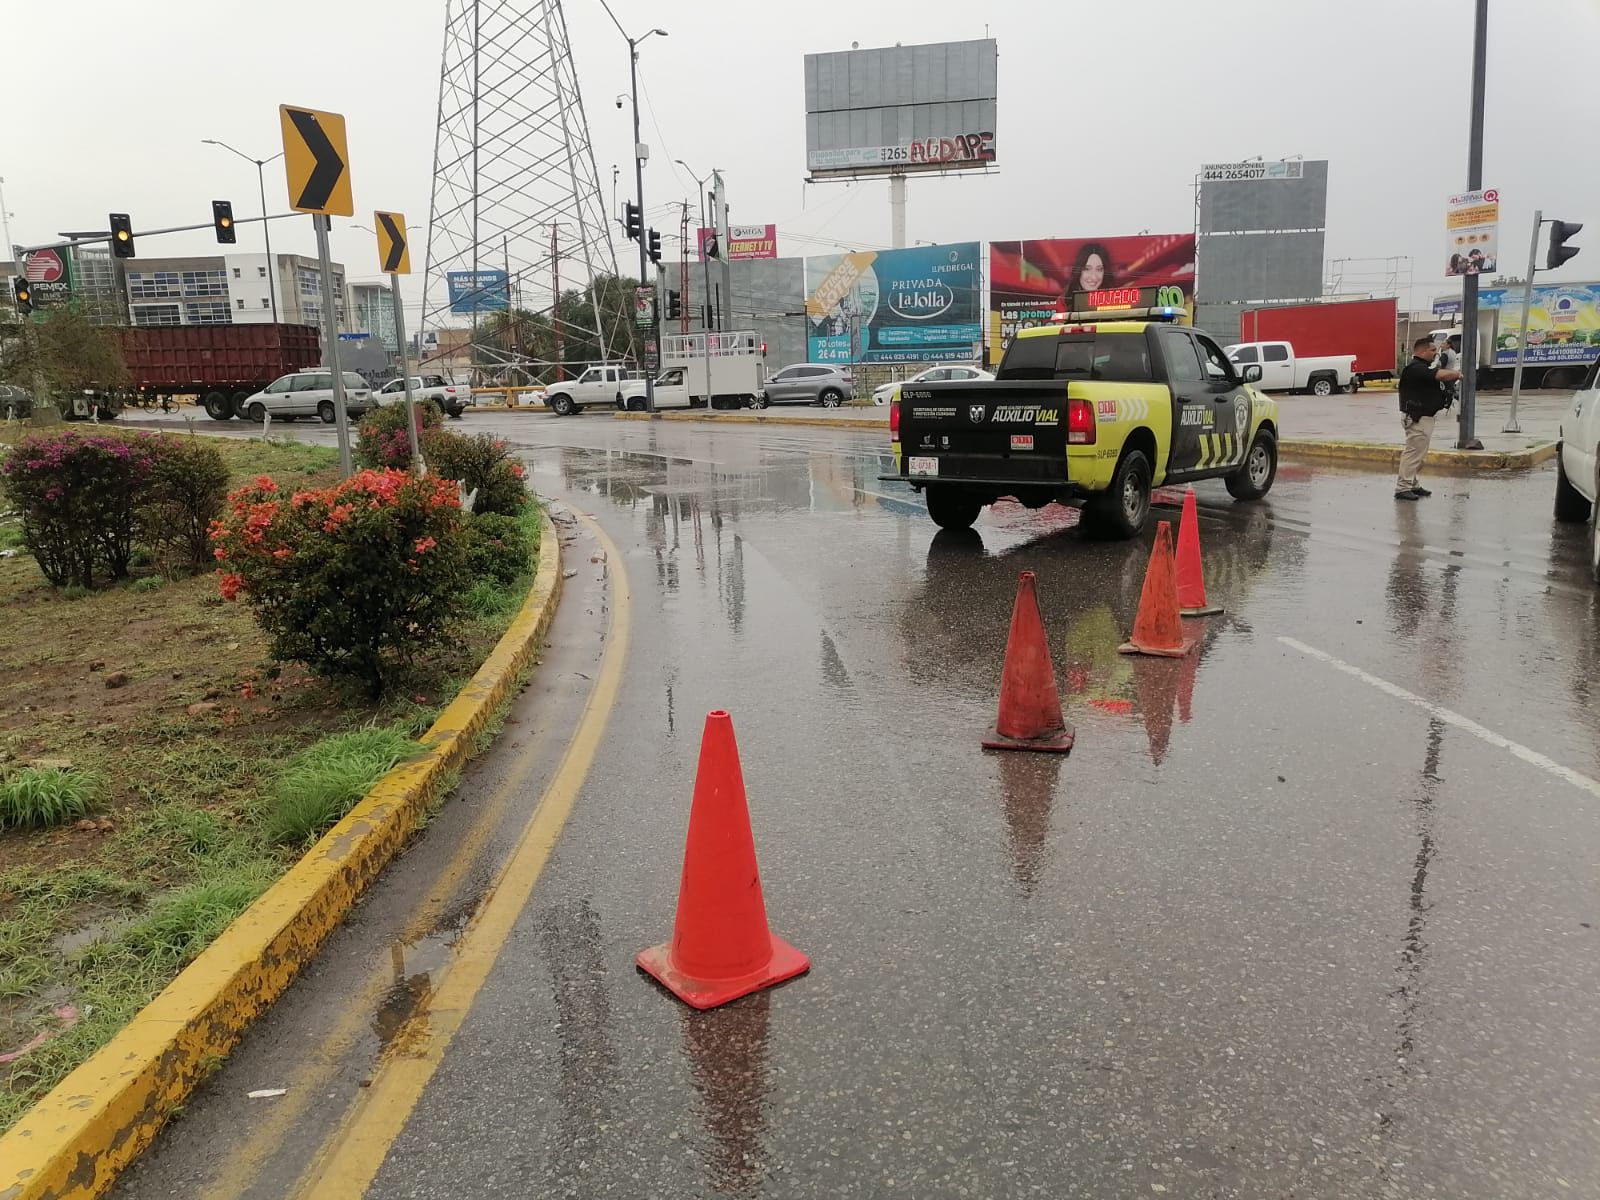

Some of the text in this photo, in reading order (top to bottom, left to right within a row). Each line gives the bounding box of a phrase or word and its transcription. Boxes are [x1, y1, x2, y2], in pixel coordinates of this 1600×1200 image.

[911, 131, 996, 163] ALDAPE
[1204, 169, 1265, 180] 444 2654017
[765, 240, 773, 251] TV
[937, 262, 975, 272] PEDREGAL
[33, 282, 68, 291] PEMEX
[891, 278, 942, 290] PRIVADA
[898, 291, 945, 309] La Jolla
[1089, 289, 1139, 305] MOJADO
[1001, 310, 1018, 320] Las
[817, 340, 827, 348] 70
[1098, 400, 1117, 413] 911
[991, 409, 1059, 422] AUXILIO VIAL
[1180, 409, 1215, 426] AUXILIO VIAL
